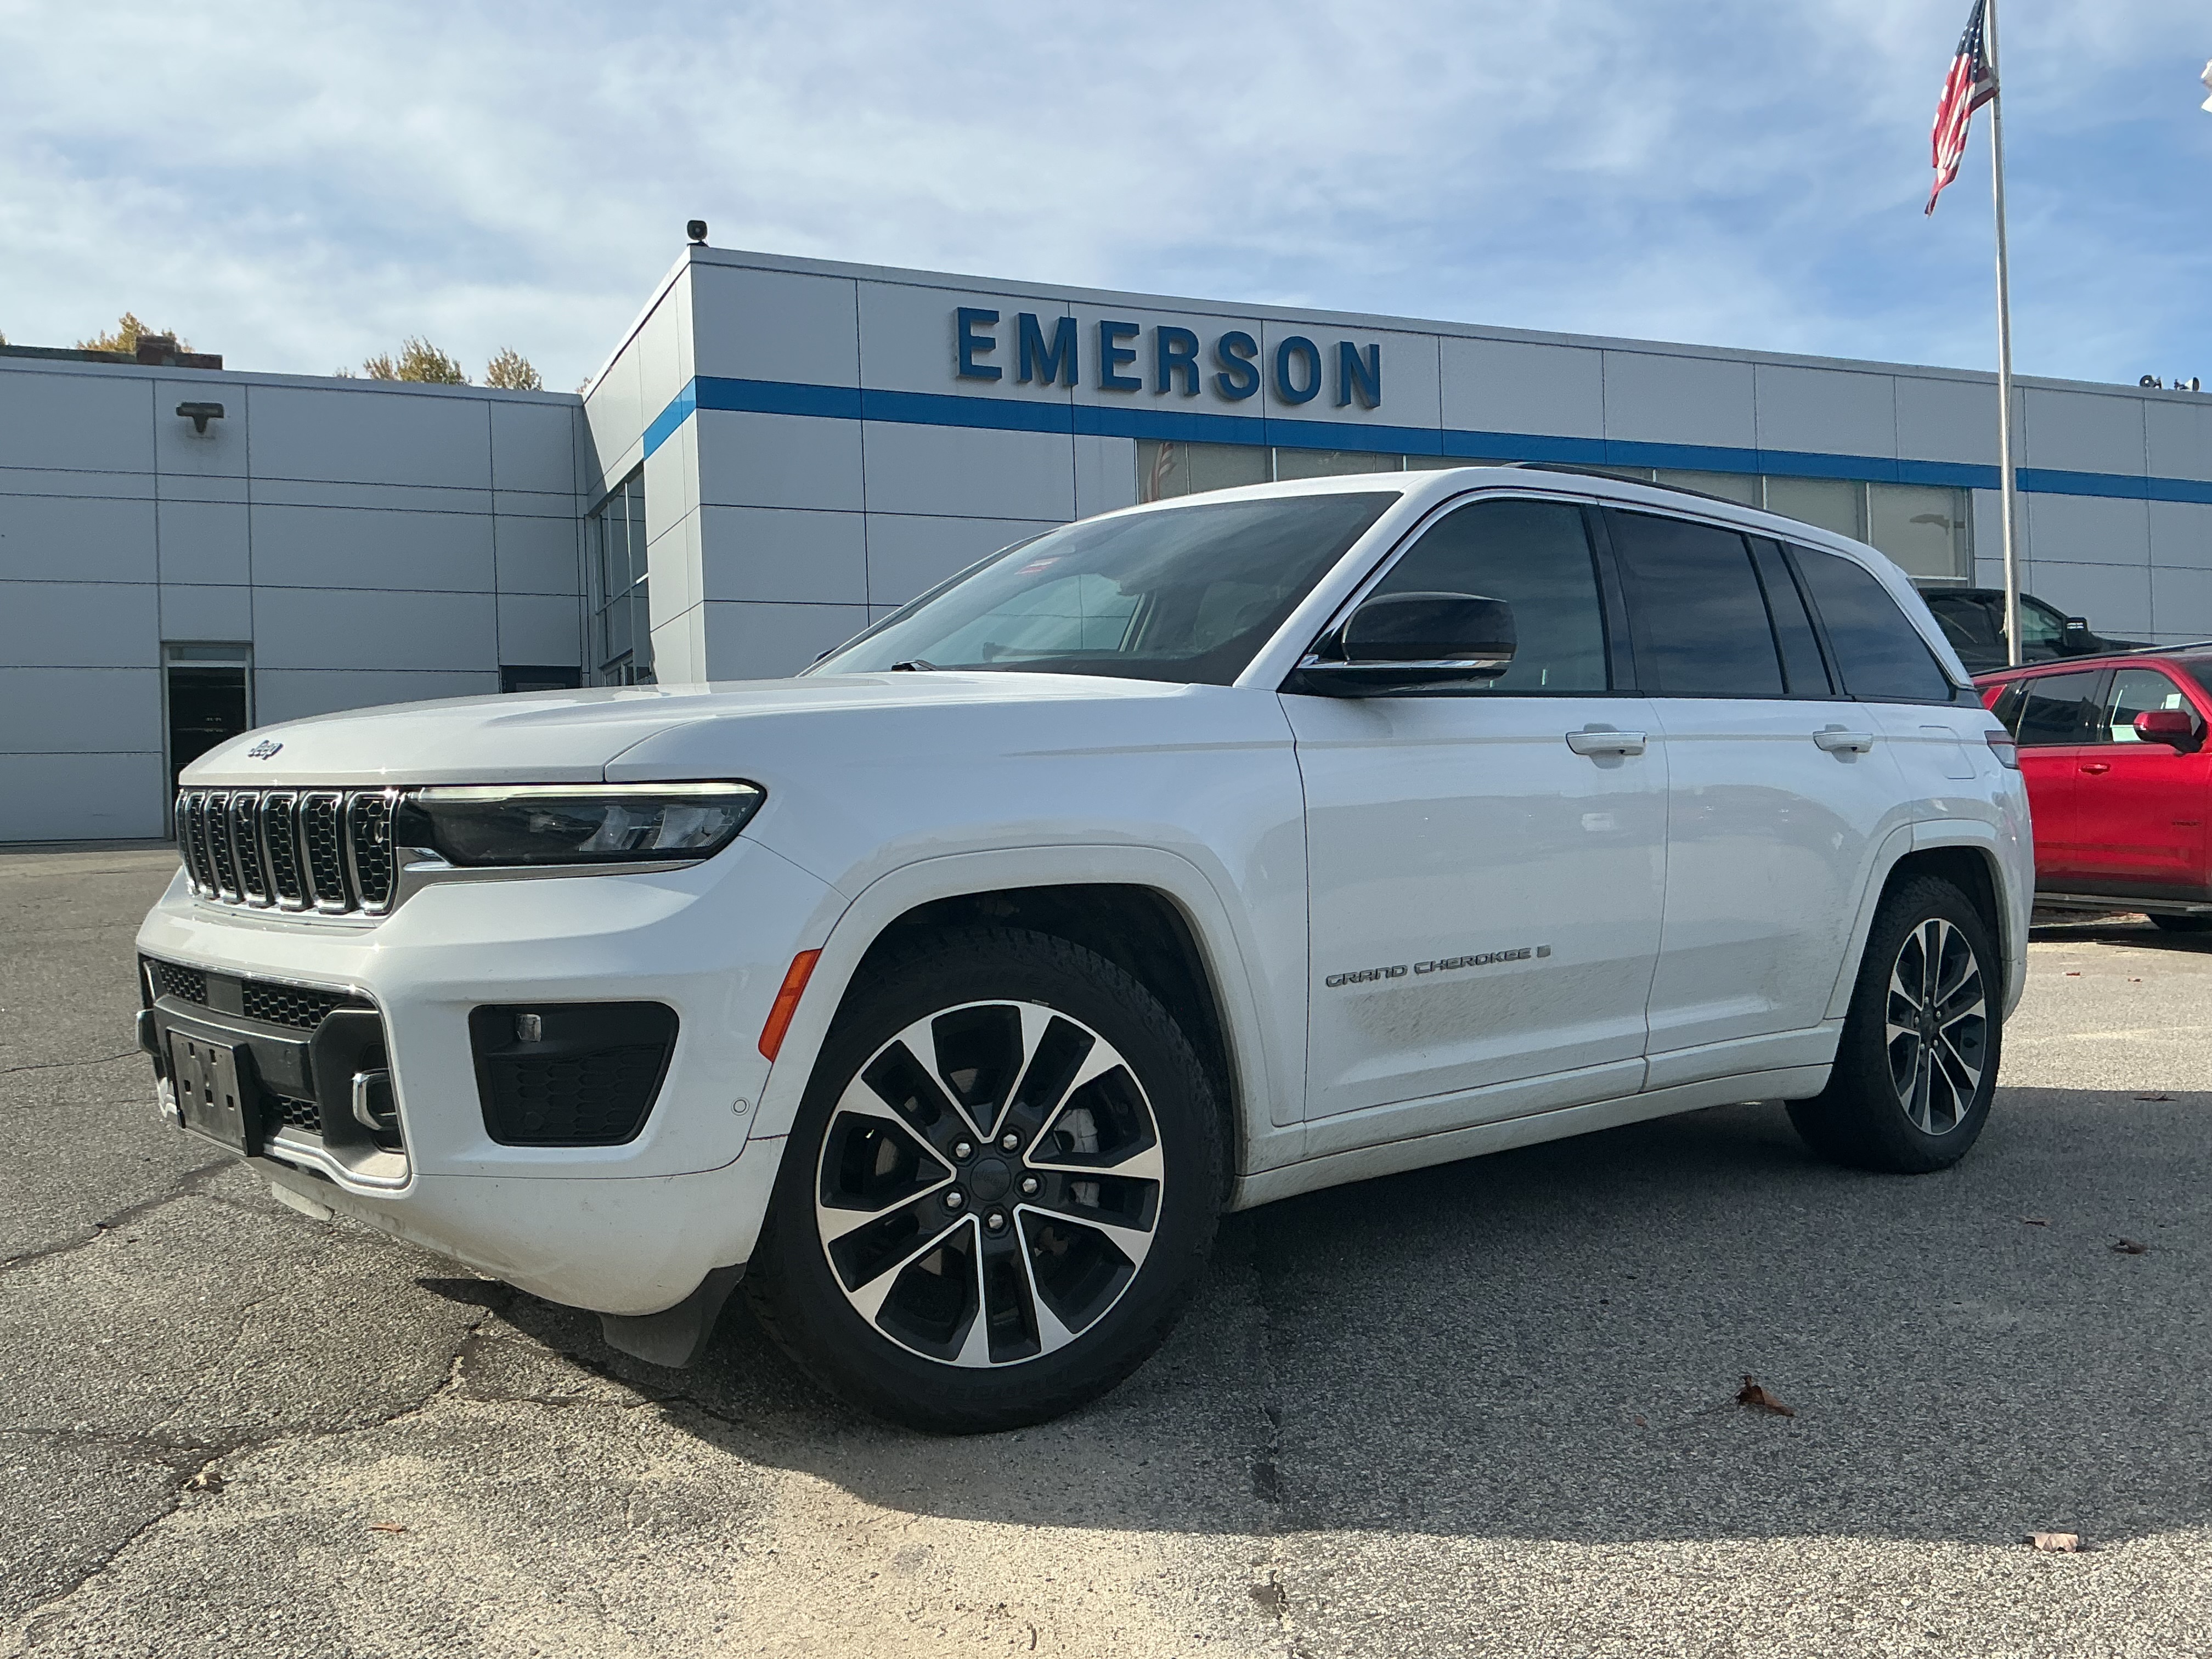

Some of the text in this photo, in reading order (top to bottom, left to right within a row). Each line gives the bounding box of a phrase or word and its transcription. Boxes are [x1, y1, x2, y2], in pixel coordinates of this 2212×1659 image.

[956, 307, 1381, 409] EMERSON
[248, 740, 284, 760] Jeep
[1326, 947, 1531, 988] GRAND CHEROKEE
